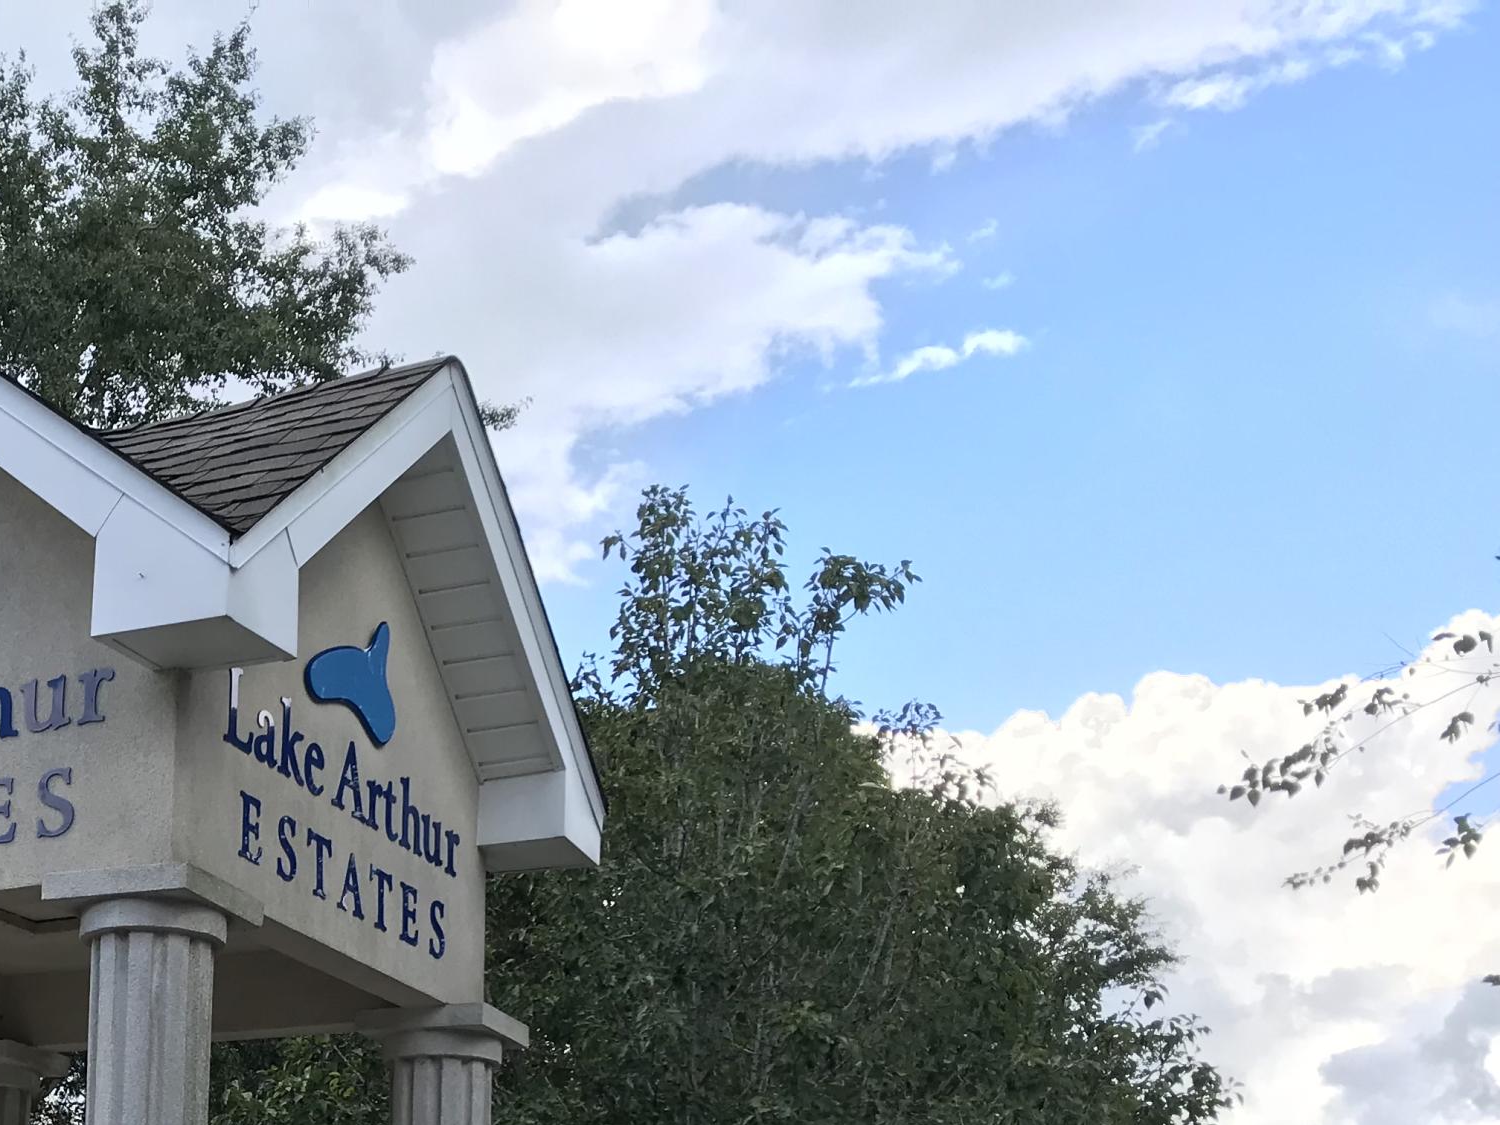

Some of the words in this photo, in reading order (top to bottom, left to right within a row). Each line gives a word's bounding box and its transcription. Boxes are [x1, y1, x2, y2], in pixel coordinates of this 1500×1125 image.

[223, 667, 325, 796] Lake
[331, 741, 460, 878] Arthur
[238, 790, 445, 959] ESTATES
